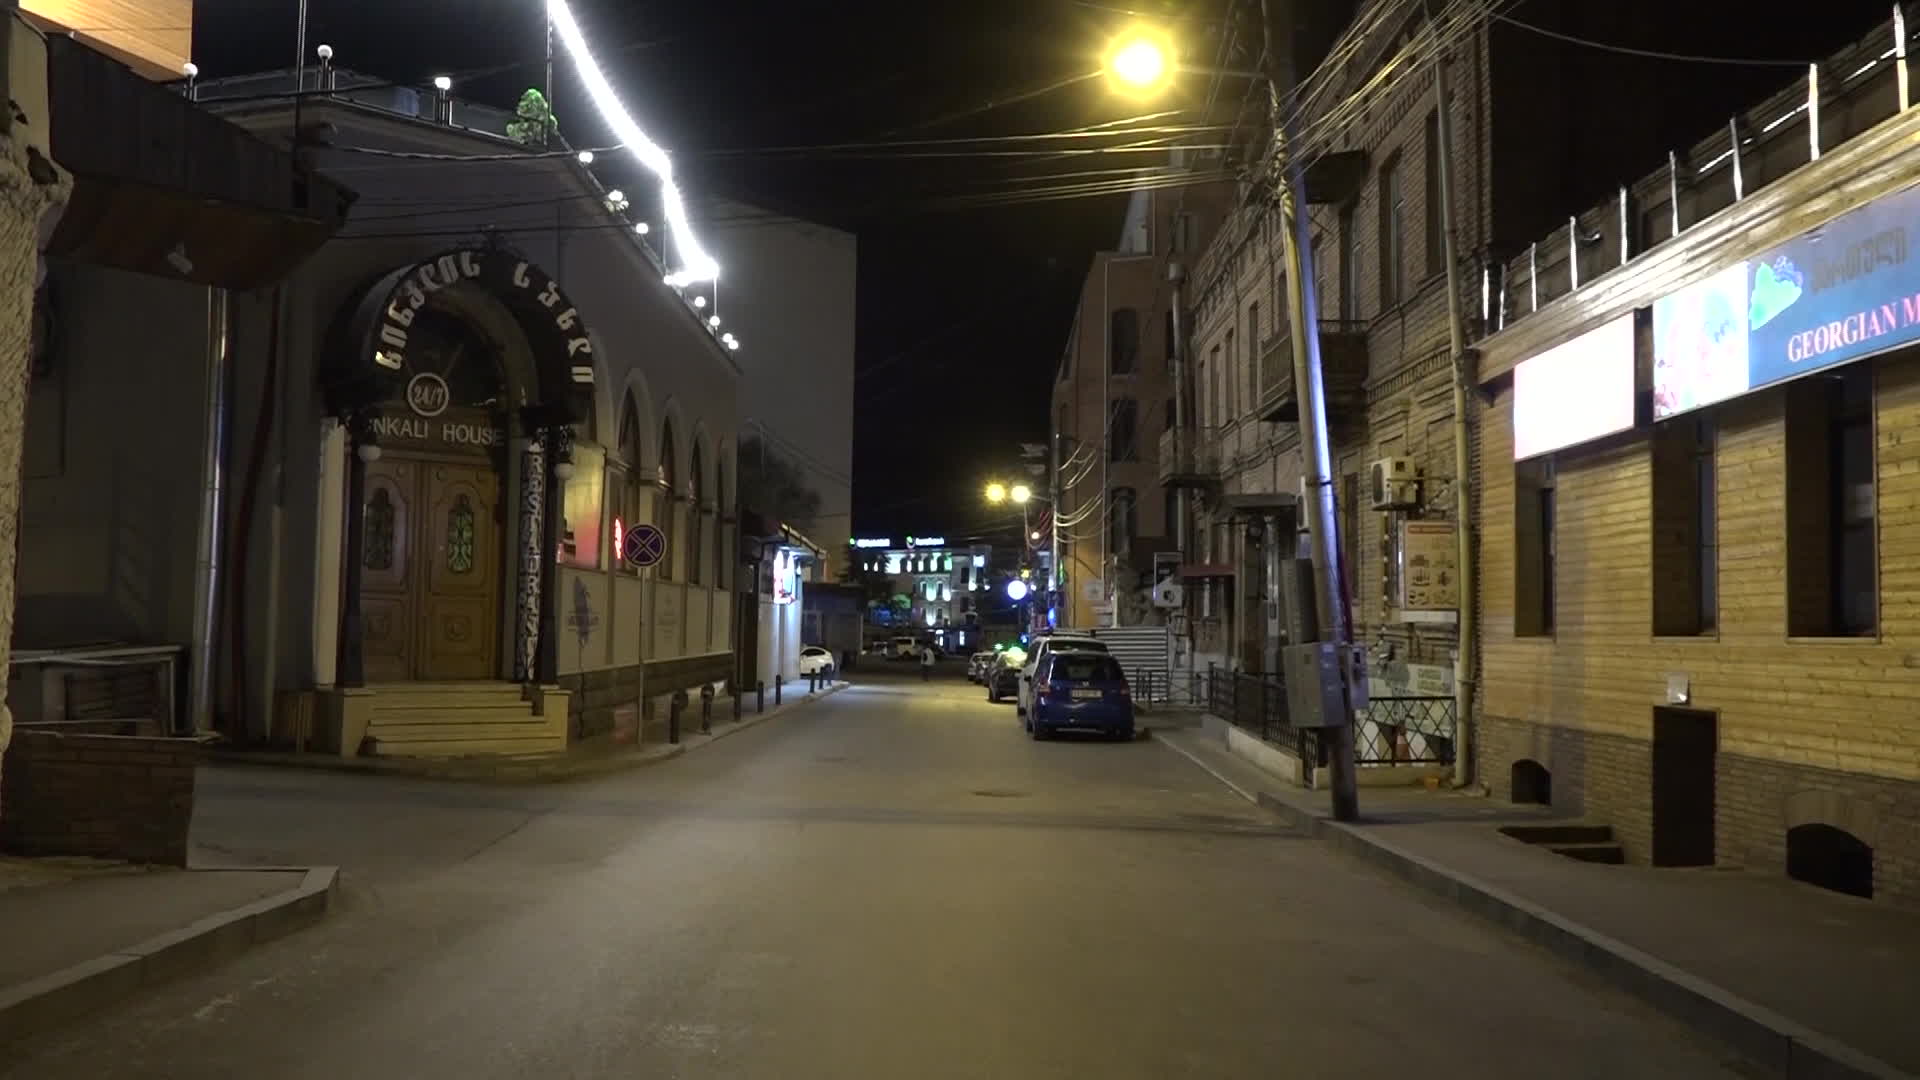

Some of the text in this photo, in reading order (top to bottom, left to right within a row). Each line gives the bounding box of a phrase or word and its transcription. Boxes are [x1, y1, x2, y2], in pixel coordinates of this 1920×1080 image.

[1788, 302, 1897, 362] GEORGIAN
[412, 386, 443, 407] 24/7
[369, 416, 504, 446] NKALI HOUSE
